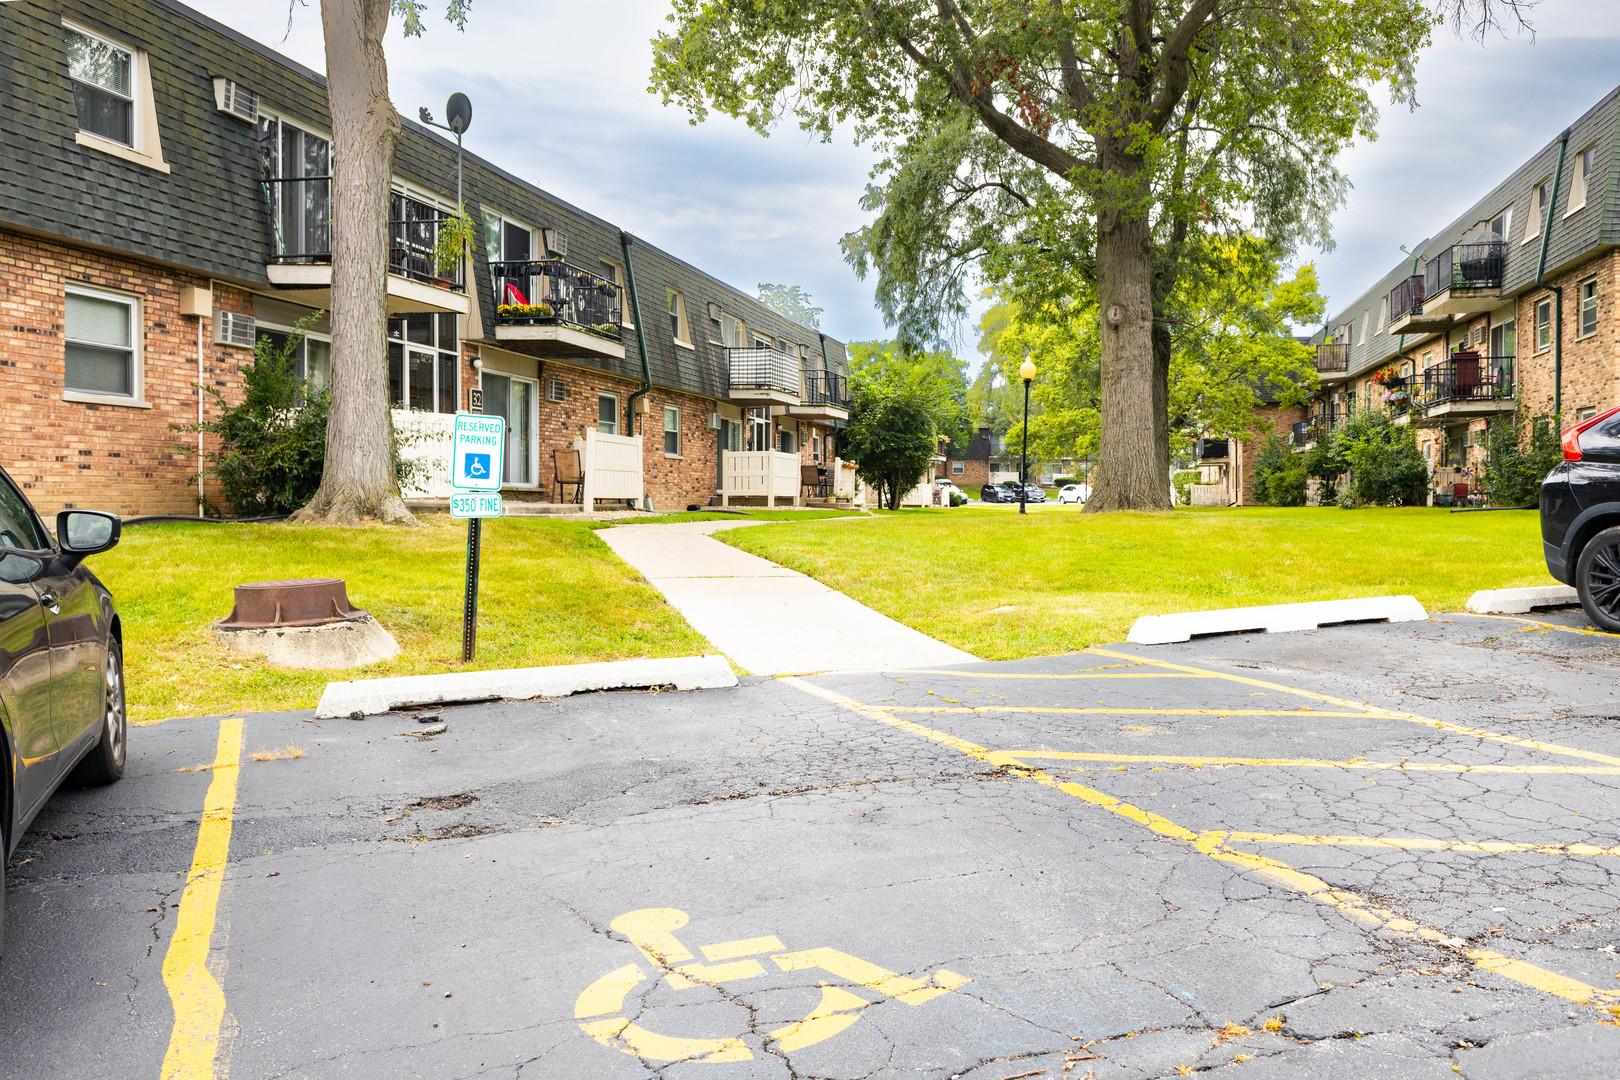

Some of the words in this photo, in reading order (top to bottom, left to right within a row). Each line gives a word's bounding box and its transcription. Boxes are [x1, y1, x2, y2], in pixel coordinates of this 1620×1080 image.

[472, 392, 482, 406] 32
[457, 421, 501, 434] RESERVED
[460, 434, 497, 446] PARKING
[453, 498, 476, 512] $350
[480, 498, 498, 512] FINE
